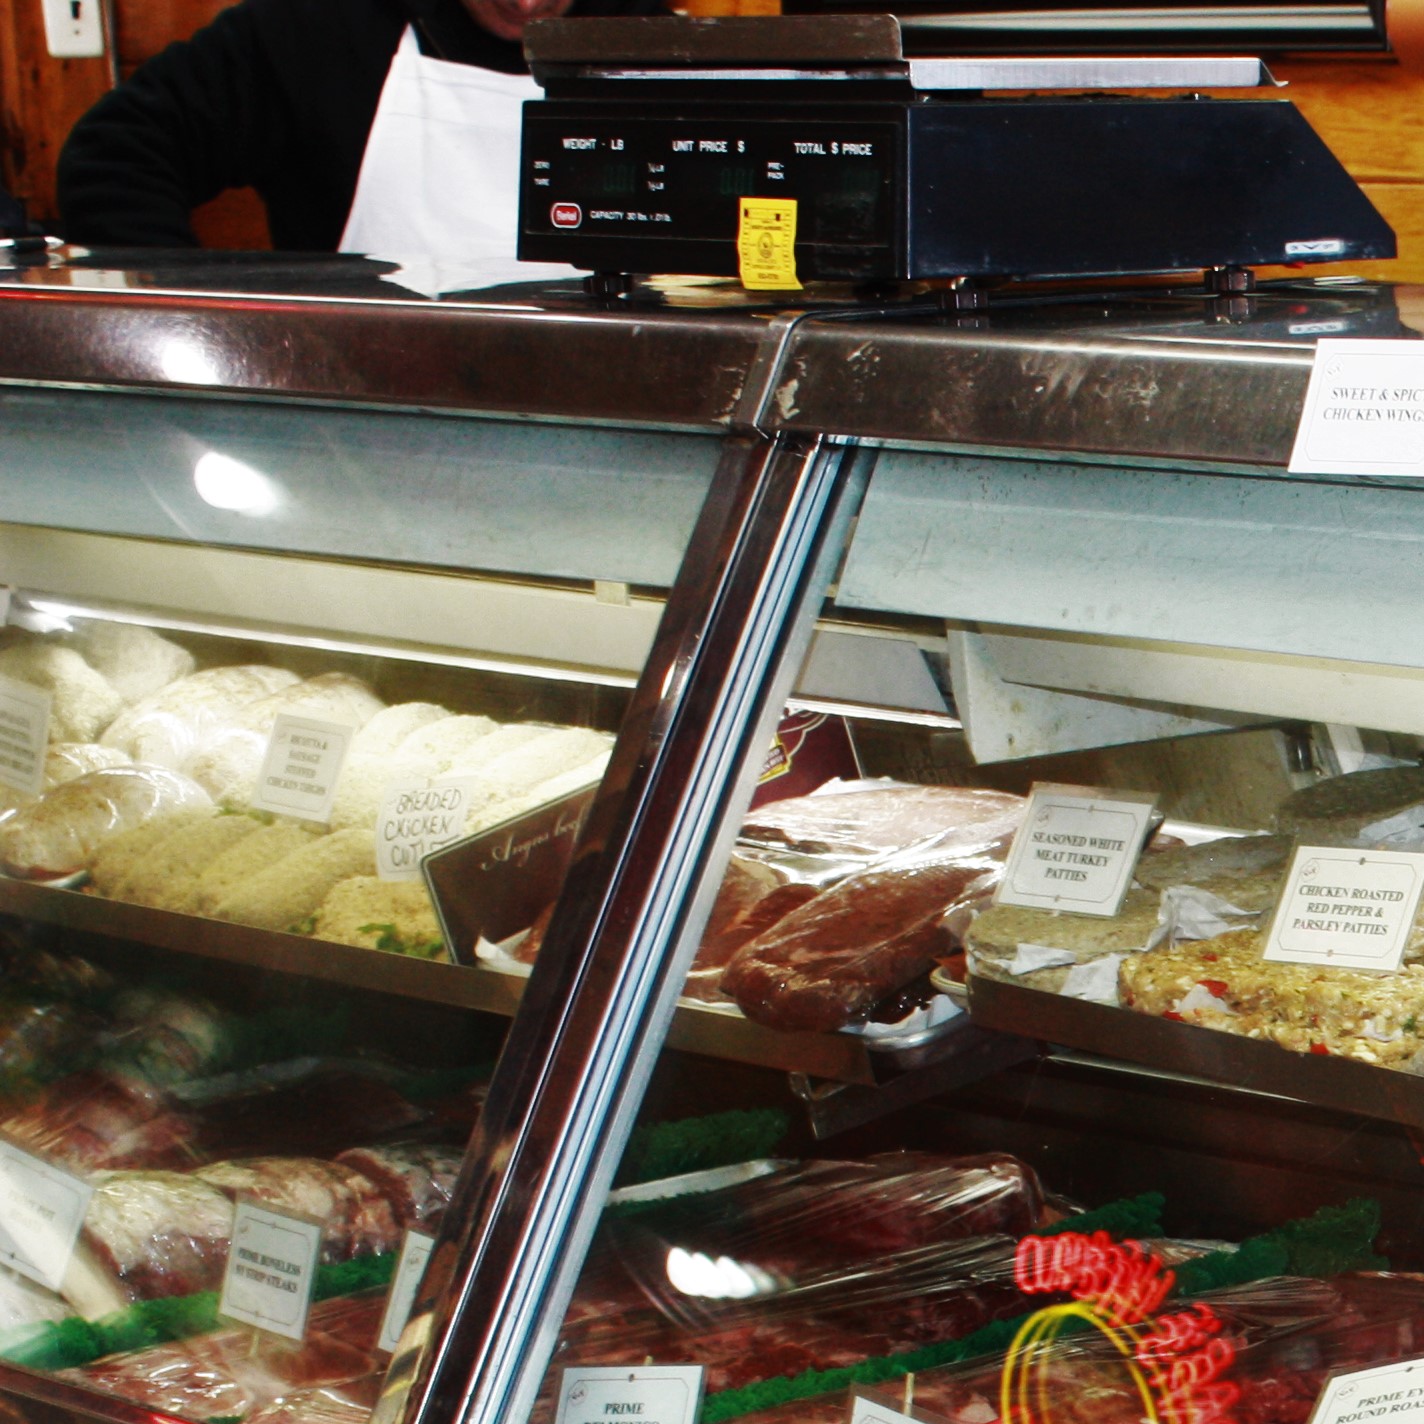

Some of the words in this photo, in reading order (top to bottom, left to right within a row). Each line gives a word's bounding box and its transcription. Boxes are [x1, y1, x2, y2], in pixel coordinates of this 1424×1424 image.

[562, 138, 597, 150] WEIGHT
[610, 139, 624, 150] LB
[672, 140, 694, 151] UNIT
[699, 141, 728, 153] PRICE
[794, 142, 826, 155] TOTAL
[842, 143, 872, 155] PRICE
[1330, 387, 1376, 402] SWEET
[1378, 389, 1388, 402] &
[1322, 407, 1383, 422] CHICKEN
[396, 788, 462, 814] BREADED
[384, 814, 454, 841] CHICKEN
[1032, 831, 1086, 849] SEASONED
[1089, 836, 1126, 852] WHITE
[1036, 848, 1065, 863] MEAT
[1067, 851, 1108, 868] TURKEY
[1044, 866, 1088, 883] PATTIES
[1298, 885, 1349, 900] CHICKEN
[1352, 888, 1404, 903] ROASTED
[1306, 902, 1329, 915] RED
[1331, 903, 1373, 918] PEPPER
[1374, 905, 1383, 918] &
[1293, 918, 1340, 932] PARSLEY
[1342, 922, 1388, 936] PATTIES
[1357, 1388, 1404, 1408] PRIME
[604, 1402, 645, 1416] PRIME
